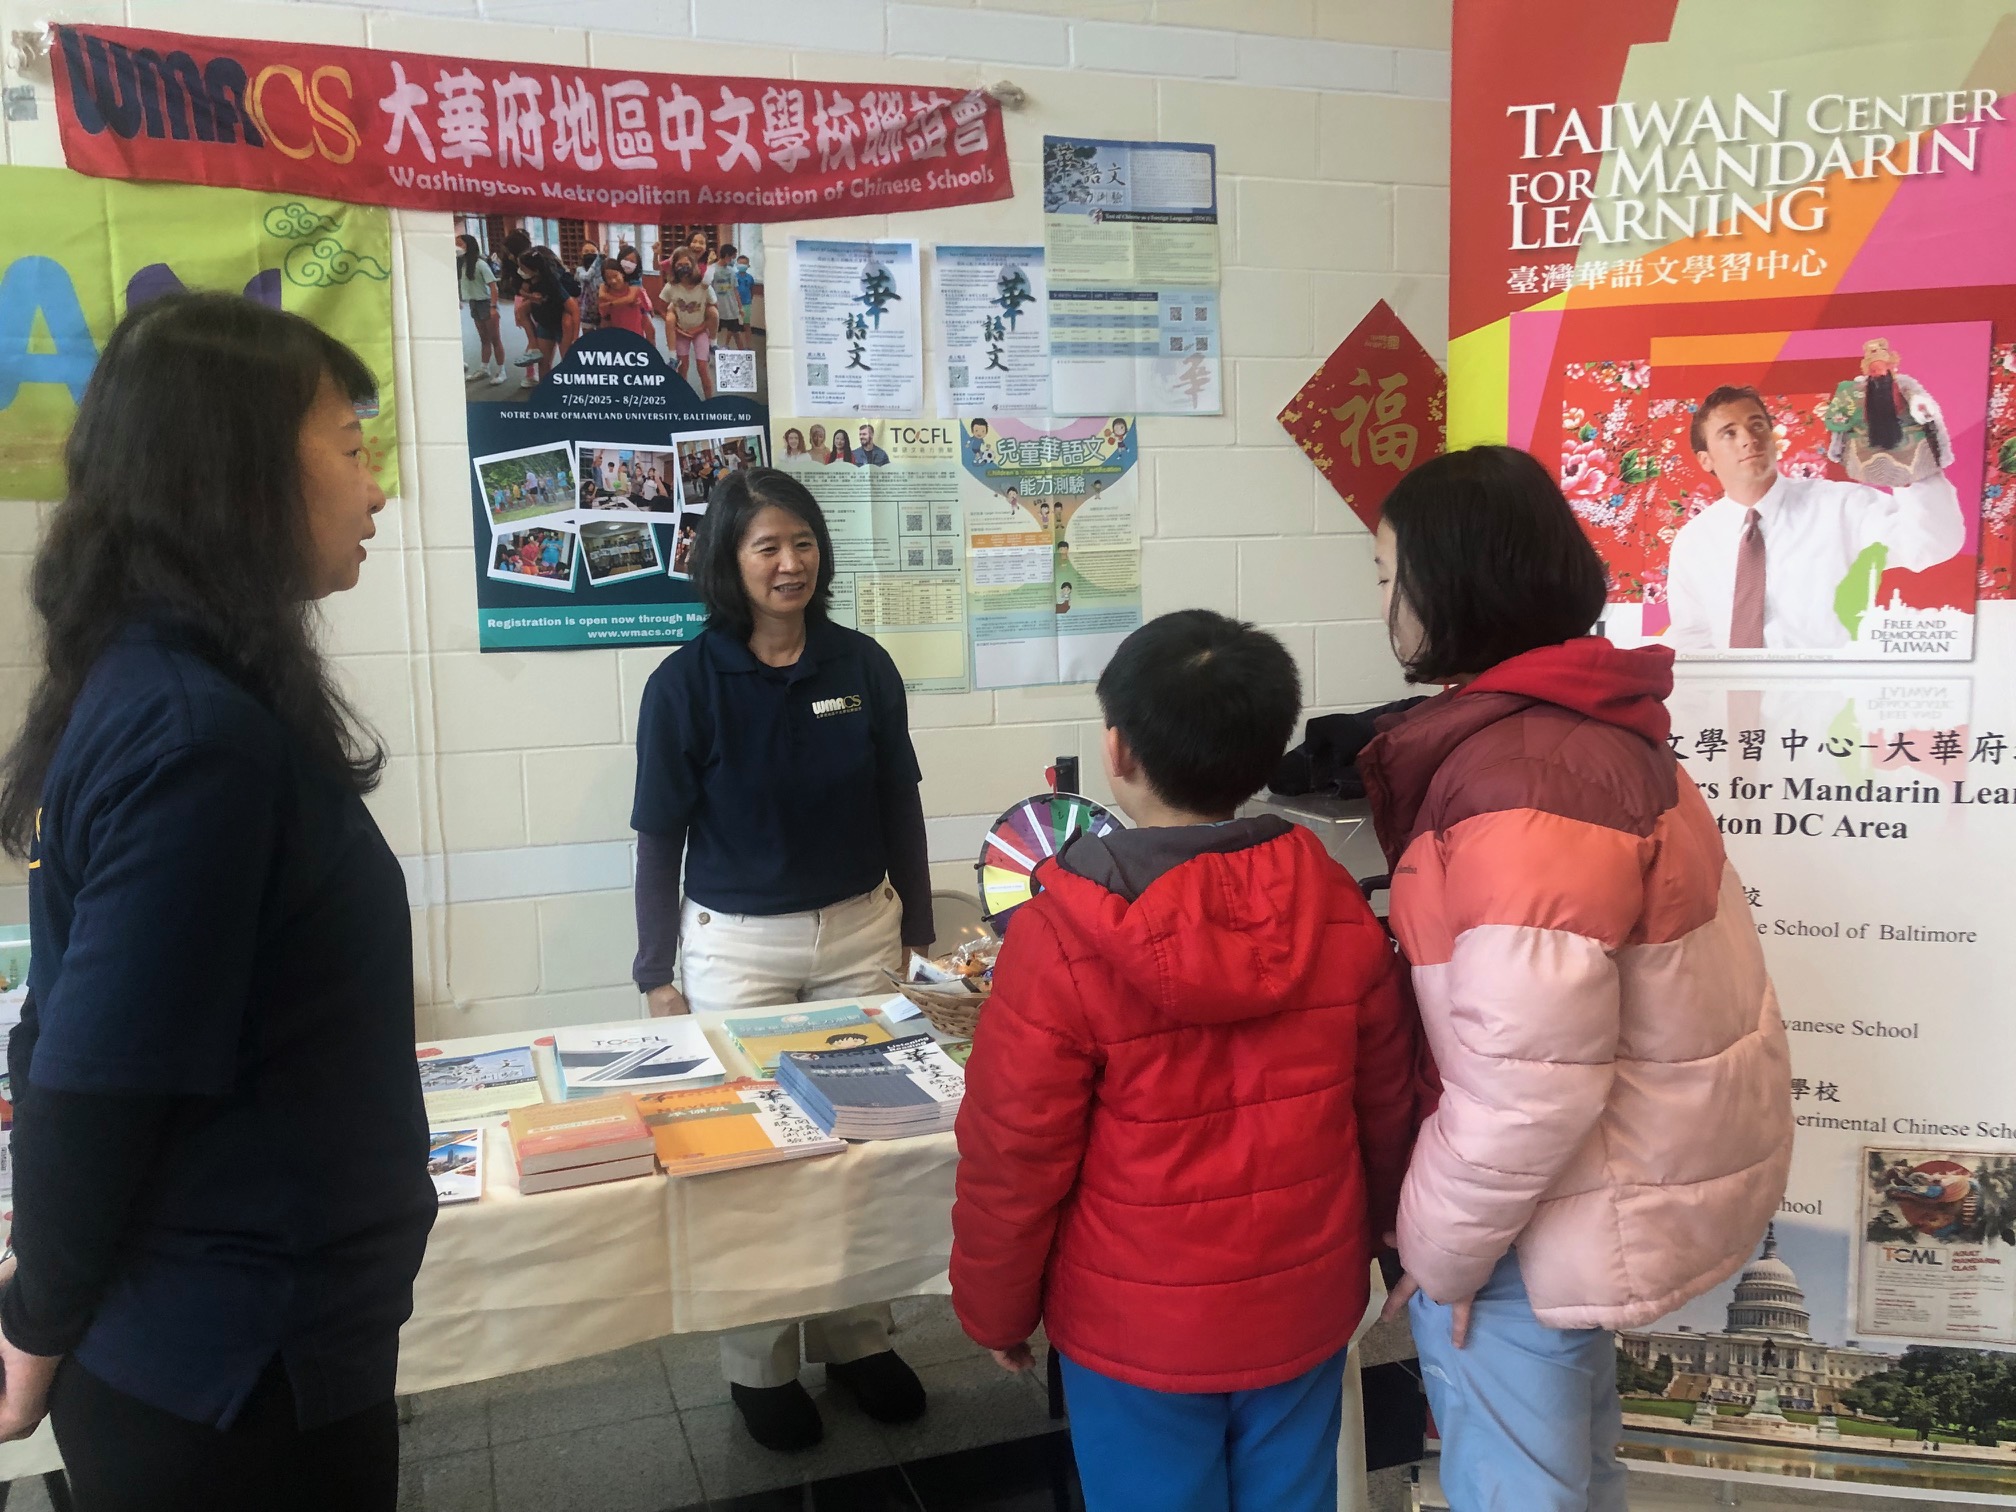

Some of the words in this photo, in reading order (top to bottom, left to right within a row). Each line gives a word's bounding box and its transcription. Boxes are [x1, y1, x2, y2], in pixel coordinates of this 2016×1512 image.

[1506, 89, 1787, 159] TAIWAN
[1806, 88, 2006, 135] CENTER
[1508, 168, 1598, 206] FOR
[1607, 127, 1983, 197] MANDARIN
[388, 166, 536, 196] Washington
[541, 182, 690, 207] Metropolitan
[698, 186, 818, 206] Association
[825, 180, 844, 200] of
[850, 176, 922, 198] Chinese
[928, 163, 994, 190] Schools
[1508, 186, 1830, 251] LEARNING
[1506, 248, 1828, 295] 臺灣華語文學習中心
[577, 351, 649, 366] WMACS
[553, 373, 619, 386] SUMMER
[623, 374, 665, 386] CAMP
[562, 395, 612, 406] 7/26/2025
[623, 396, 666, 406] 8/2/2025
[500, 411, 530, 420] NOTRE
[533, 412, 559, 420] DAME
[625, 413, 682, 422] UNIVERSITY,
[683, 413, 736, 422] BALTIMORE,
[738, 413, 751, 421] MD
[1330, 368, 1419, 471] 福
[890, 428, 953, 444] TOCFL
[996, 436, 1106, 467] 兒童華語文
[1020, 476, 1085, 496] 能力測驗
[487, 617, 561, 628] Registration
[565, 616, 575, 626] is
[579, 617, 610, 627] open
[612, 616, 635, 624] now
[639, 613, 683, 625] through
[1884, 619, 1911, 630] FREE
[1916, 619, 1946, 629] AND
[588, 627, 683, 638] www.wmacs.org
[1871, 630, 1958, 640] DEMOCRATIC
[1879, 640, 1949, 653] TAIWAN
[812, 694, 862, 715] WMACS
[1729, 777, 1773, 800] for
[1783, 778, 1940, 804] Mandarin
[1773, 812, 1824, 838] DC
[1832, 815, 1908, 839] Area
[1774, 919, 1839, 938] School
[1846, 922, 1871, 939] of
[1879, 924, 1977, 943] Baltimore
[1852, 1019, 1919, 1039] School
[887, 1036, 929, 1050] Listening
[1790, 1078, 1840, 1102] 學校
[1796, 1112, 1887, 1133] erimental
[1893, 1117, 1970, 1137] Chinese
[1780, 1196, 1822, 1215] hool
